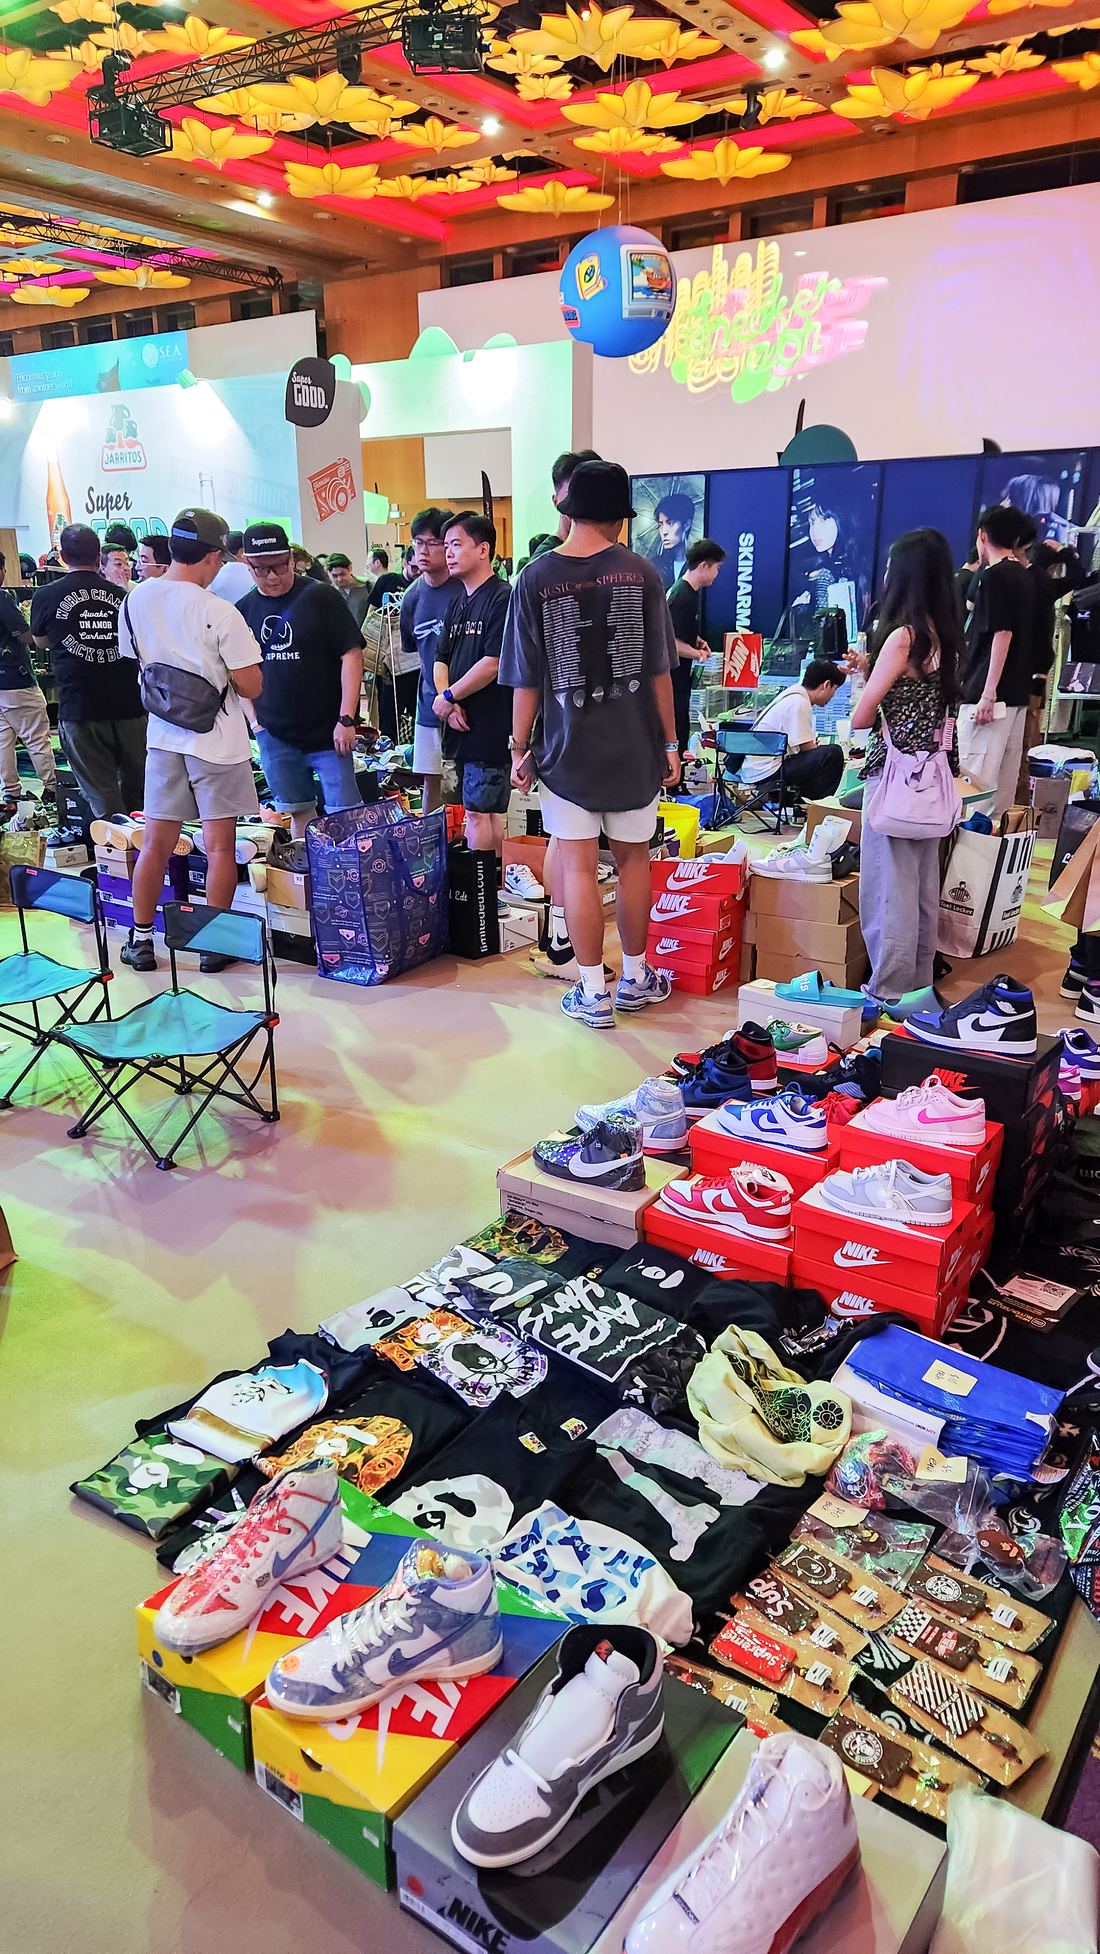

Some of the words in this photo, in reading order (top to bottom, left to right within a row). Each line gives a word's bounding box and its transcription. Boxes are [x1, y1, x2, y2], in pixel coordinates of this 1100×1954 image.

[291, 371, 313, 385] Super
[293, 383, 329, 409] GOOD.
[104, 450, 143, 465] JARRITOS
[85, 485, 133, 519] Super
[251, 537, 277, 547] Supreme
[55, 588, 90, 620] WORLD
[78, 620, 91, 629] UN
[92, 620, 113, 629] AMOR
[61, 633, 96, 662] BACK
[96, 648, 105, 663] 2
[728, 639, 750, 683] NIKE
[674, 862, 710, 879] NIKE
[476, 860, 489, 953] limitededt.com
[656, 892, 692, 911] NIKE
[660, 937, 680, 949] NIKE
[693, 1248, 727, 1268] NIKE
[842, 1240, 880, 1262] NIKE
[839, 1290, 876, 1312] NIKE
[720, 1628, 780, 1666] Supreme
